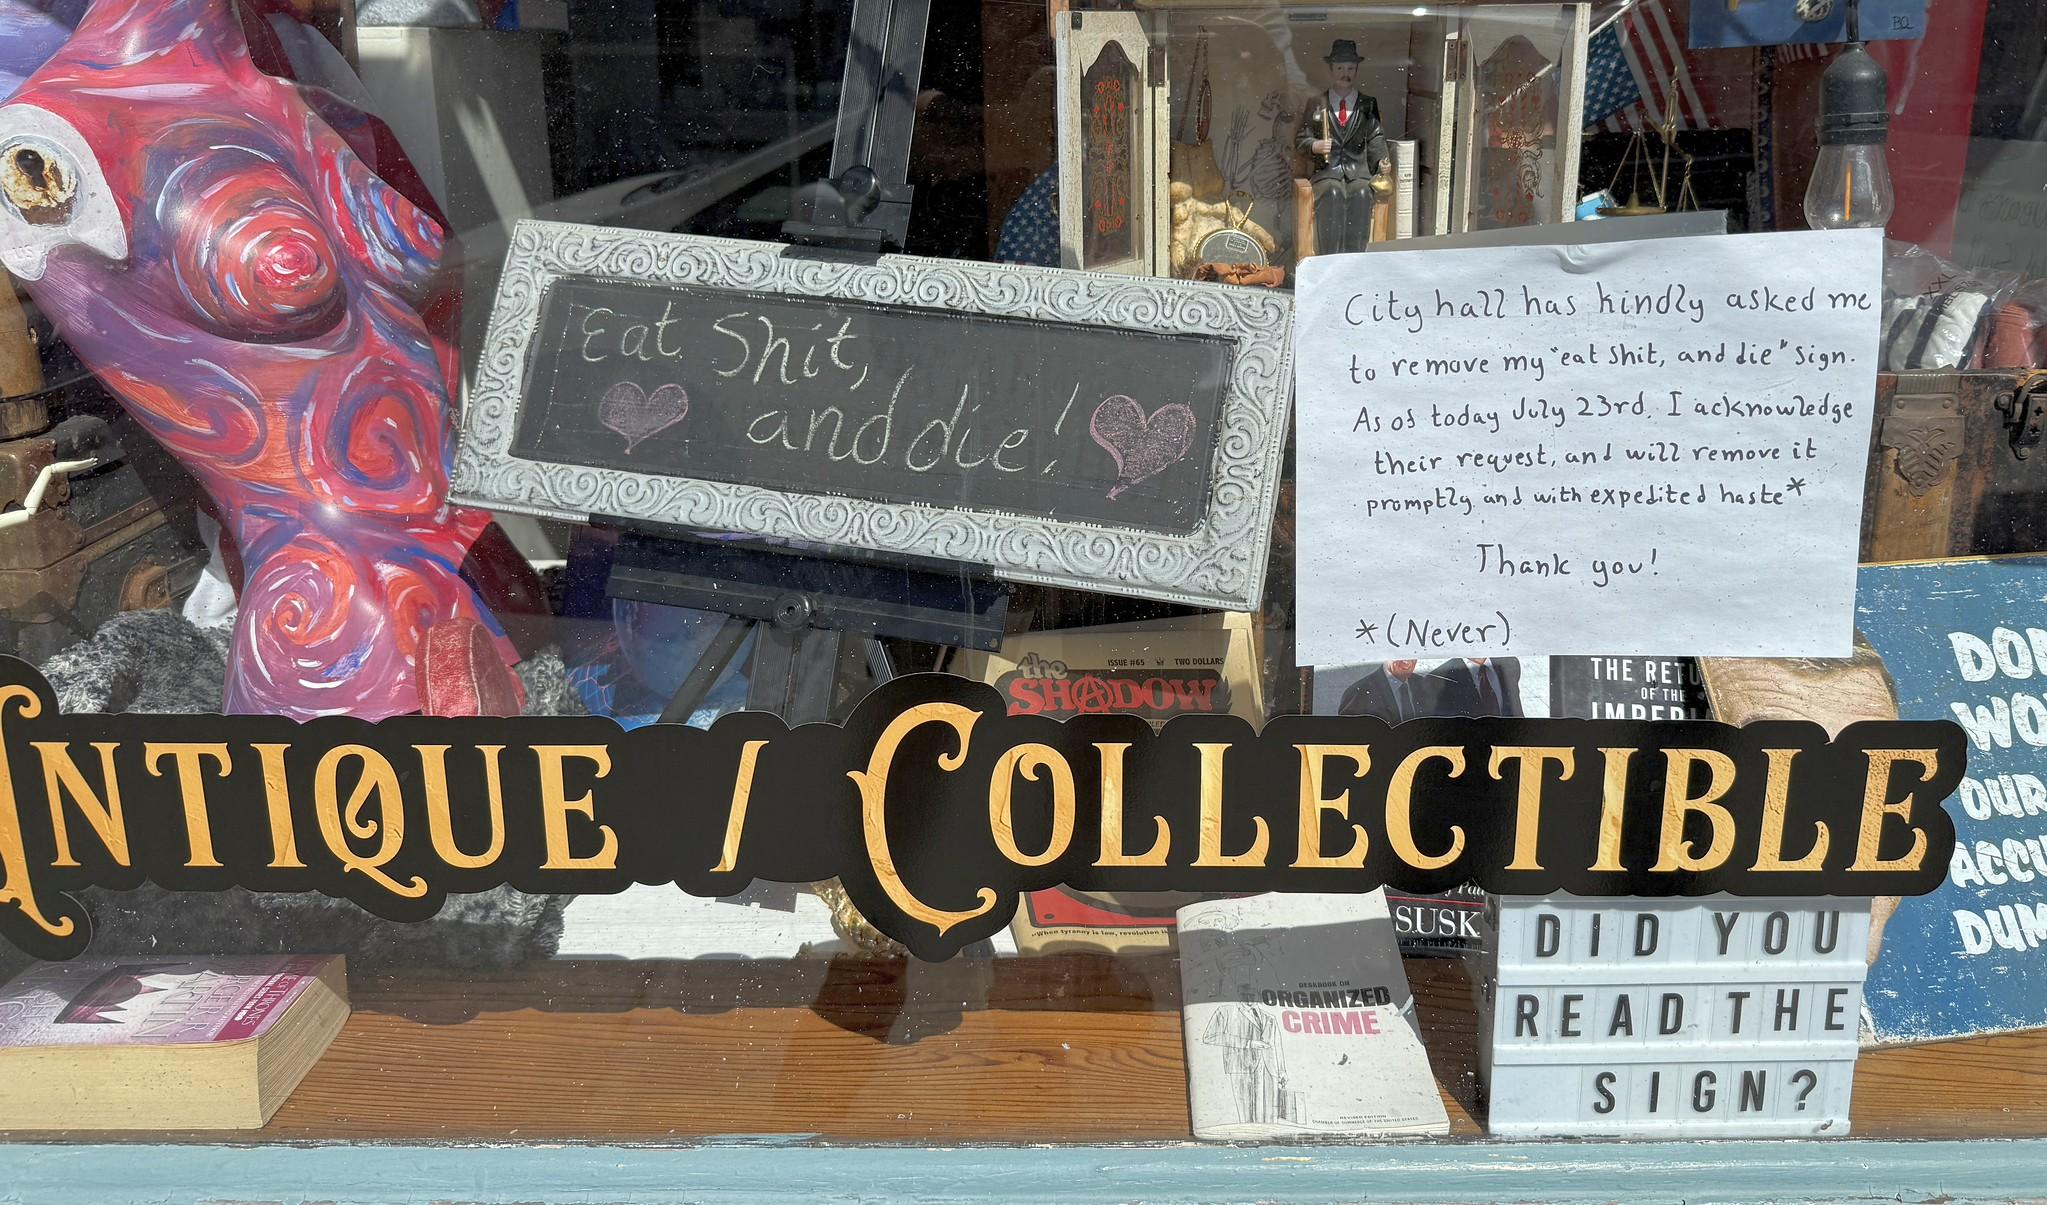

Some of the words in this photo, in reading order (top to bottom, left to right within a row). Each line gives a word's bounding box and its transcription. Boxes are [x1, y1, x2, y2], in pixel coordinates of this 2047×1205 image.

[1345, 290, 1423, 333] City
[1436, 289, 1505, 318] hall
[1522, 285, 1576, 316] has
[1597, 282, 1704, 323] kindly
[1726, 287, 1815, 312] asked
[1828, 293, 1871, 310] me
[581, 300, 682, 363] Eat
[1350, 354, 1376, 384] to
[1392, 358, 1489, 376] remove
[1504, 356, 1544, 381] my
[1678, 343, 1725, 363] and
[747, 365, 914, 465] and
[906, 383, 1080, 474] die!
[1353, 407, 1381, 432] As
[1432, 404, 1500, 433] today
[1513, 397, 1566, 428] July
[1668, 391, 1682, 416] I
[1695, 393, 1853, 424] acknowledge
[1374, 451, 1442, 475] their
[1456, 443, 1555, 473] request,
[1565, 443, 1611, 464] and
[1626, 442, 1680, 462] will
[1693, 446, 1780, 462] remove
[1792, 437, 1817, 460] it
[1367, 487, 1472, 517] promptly
[1484, 487, 1521, 506] and
[1534, 486, 1581, 504] with
[1590, 484, 1706, 508] expedited
[1477, 544, 1570, 577] Thank
[1592, 548, 1658, 587] you!
[1016, 652, 1067, 679] the
[1107, 658, 1128, 666] ISSUE
[1129, 658, 1145, 666] #65
[1192, 657, 1225, 665] DOLLARS
[1590, 657, 1633, 682] THE
[1007, 675, 1217, 717] SHADOW
[1641, 687, 1656, 700] OF
[1662, 688, 1686, 702] THE
[1949, 692, 2047, 752] WO
[711, 739, 769, 872] /
[847, 700, 1940, 936] COLLECTIBLE
[1395, 905, 1481, 938] SUSK
[1536, 913, 1660, 957] DID
[1713, 910, 1840, 955] YOU
[1261, 985, 1391, 1009] ORGANIZED
[1515, 992, 1684, 1037] READ
[1727, 987, 1849, 1034] THE
[1281, 1010, 1382, 1035] CRIME
[1593, 1069, 1818, 1114] SIGN?
